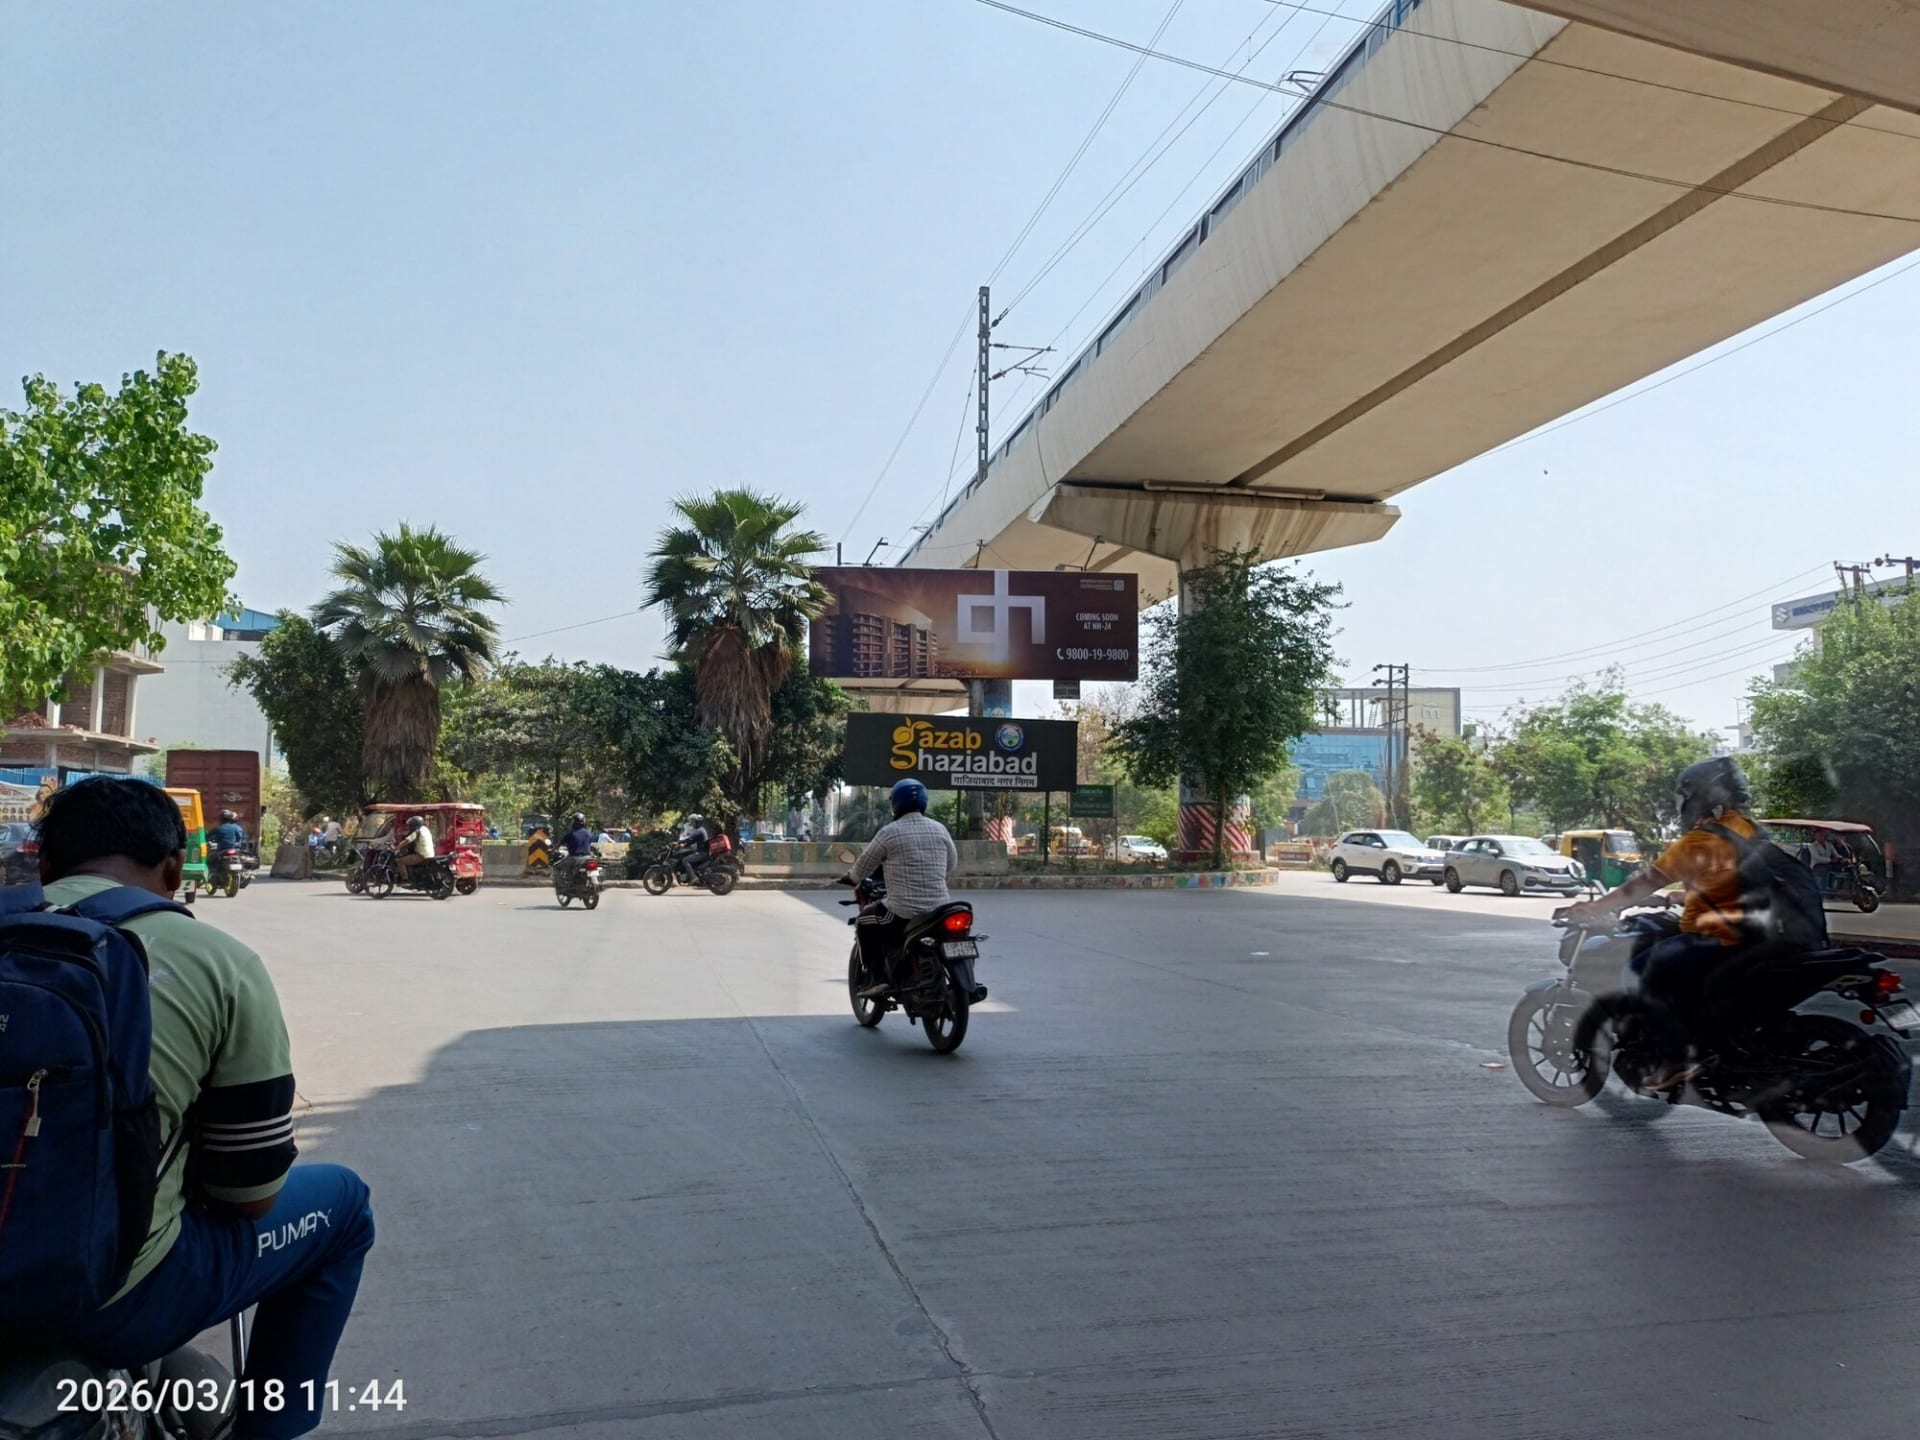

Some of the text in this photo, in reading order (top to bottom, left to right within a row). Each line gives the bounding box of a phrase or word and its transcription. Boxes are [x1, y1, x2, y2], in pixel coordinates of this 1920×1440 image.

[1075, 612, 1119, 621] COMING SOON
[1083, 622, 1111, 631] AT NH-24
[1066, 648, 1129, 660] 9800-19-9800
